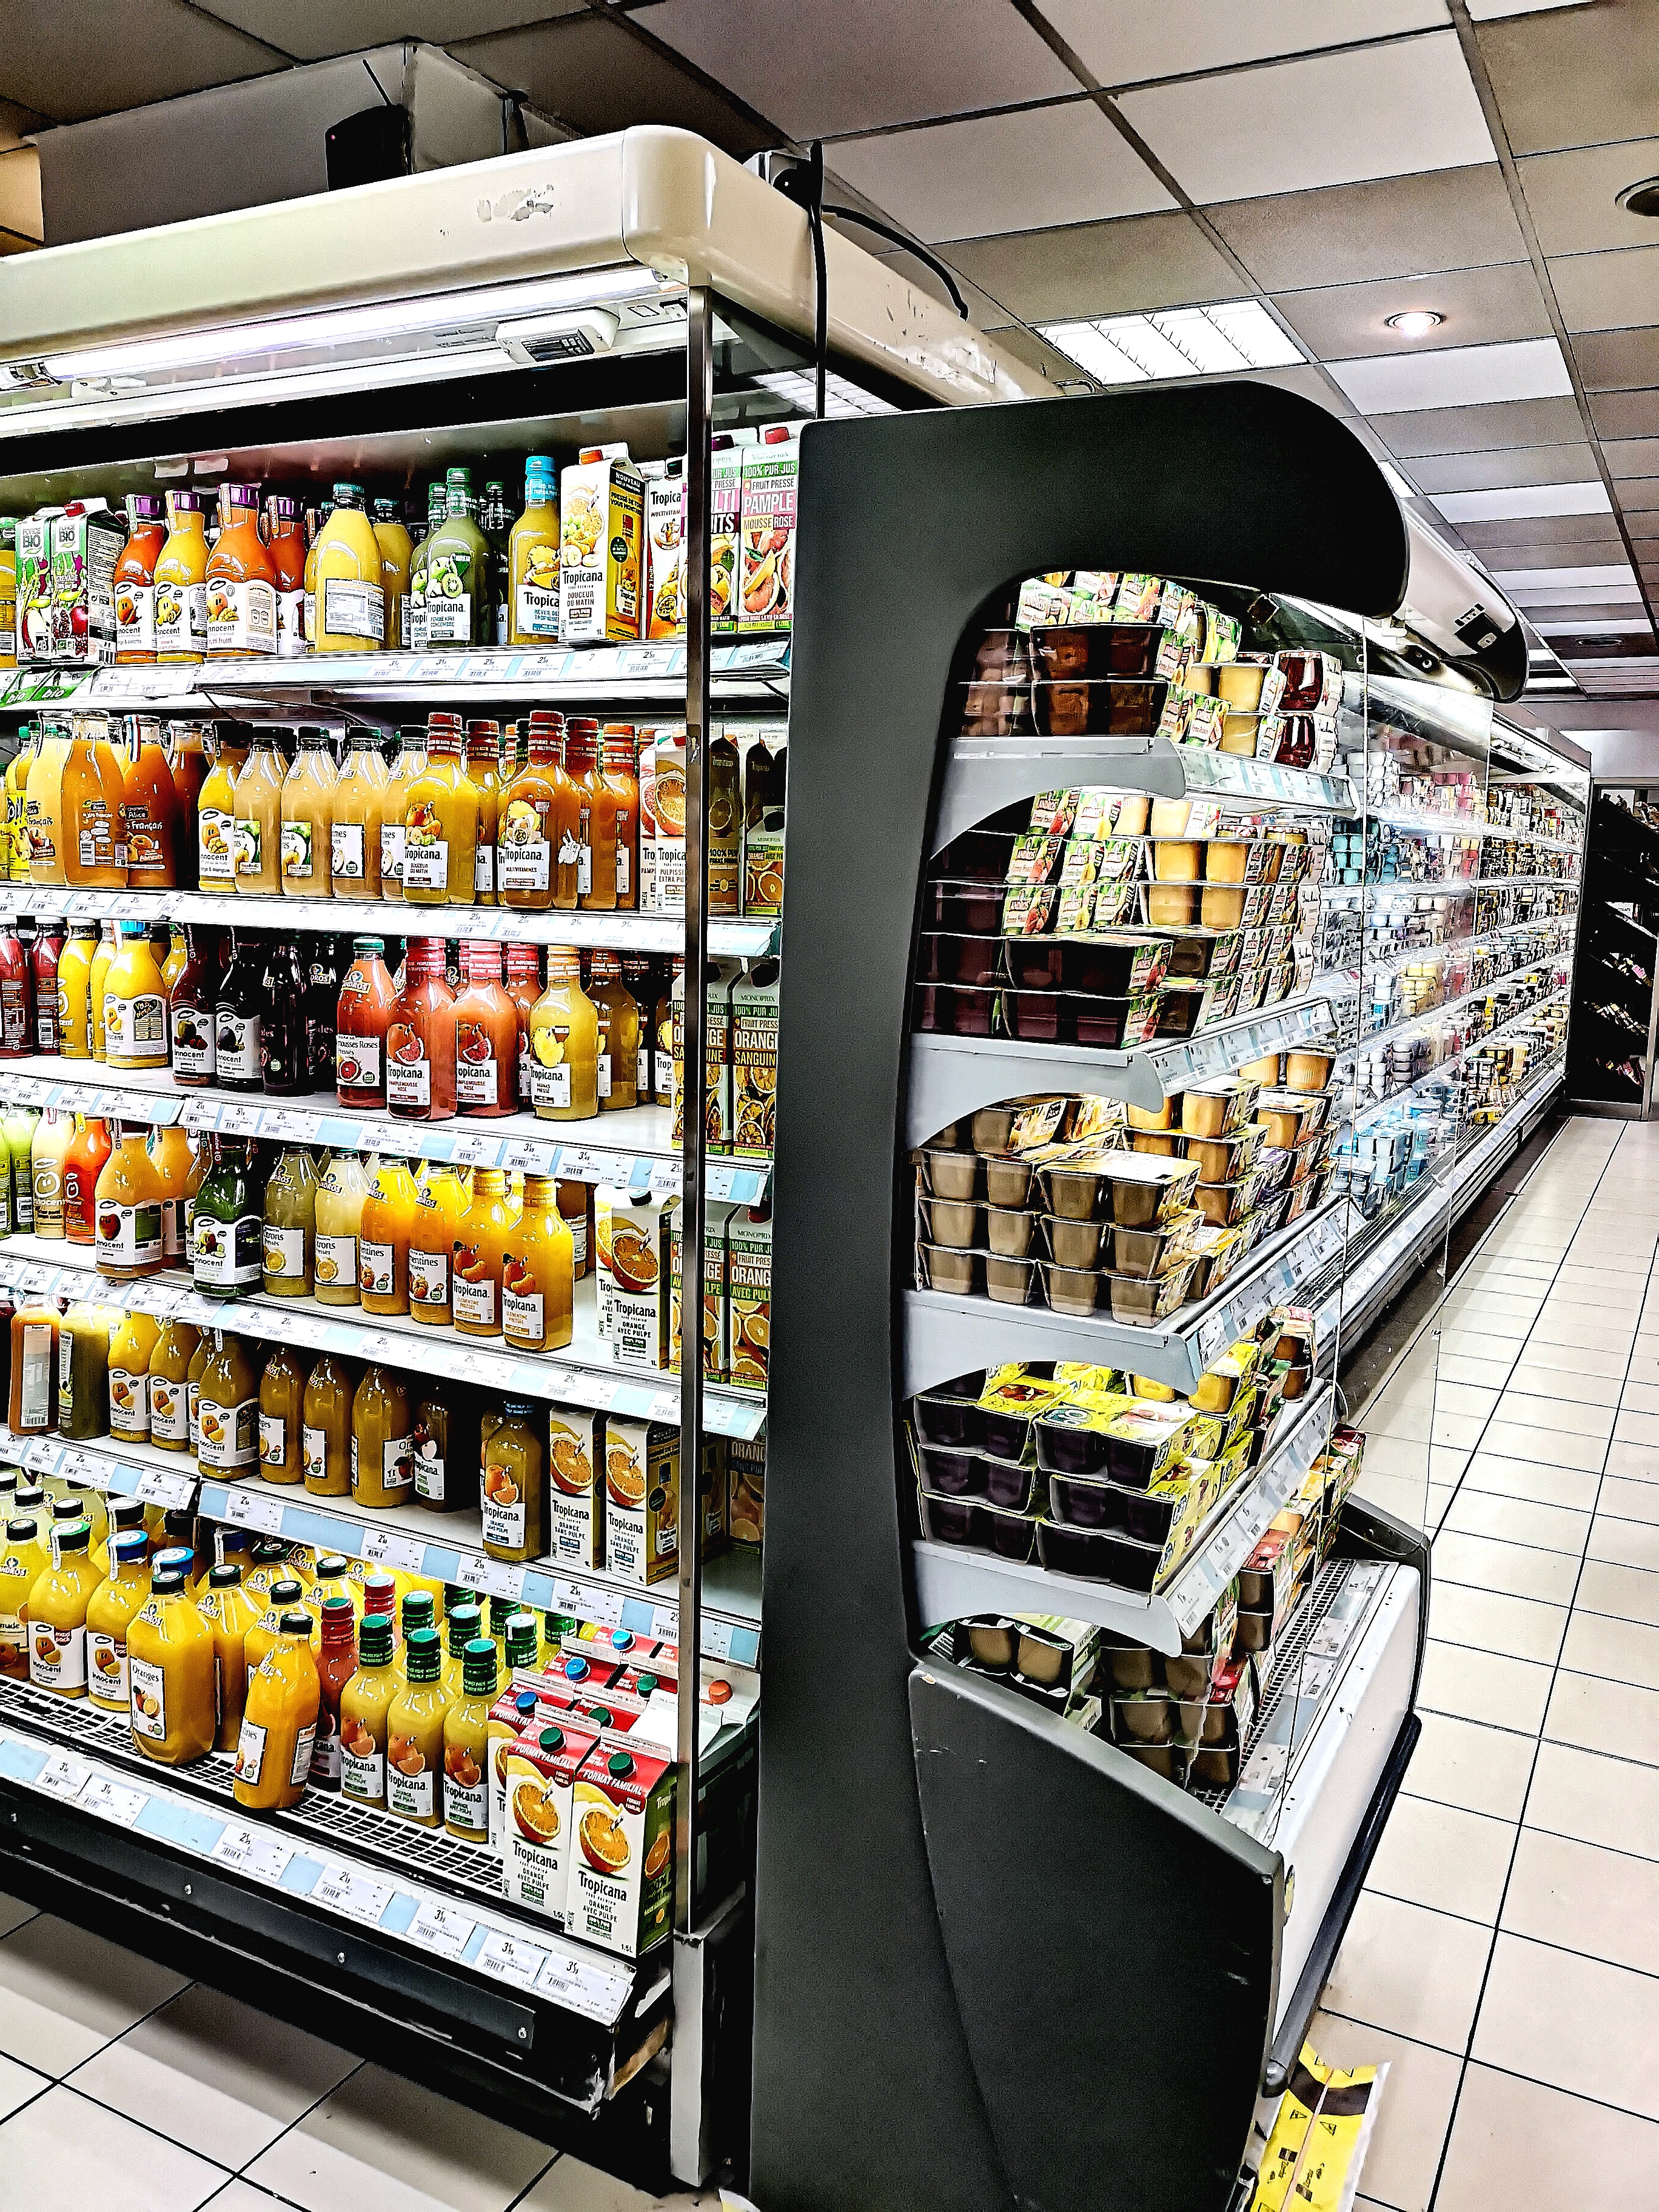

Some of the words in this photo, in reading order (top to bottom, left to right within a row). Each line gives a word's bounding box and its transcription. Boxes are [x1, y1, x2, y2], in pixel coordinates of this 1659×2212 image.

[723, 467, 737, 478] JUS
[745, 465, 763, 478] 100%
[764, 463, 779, 476] PUR
[781, 461, 796, 474] JUS
[715, 478, 736, 489] PRESSÉ
[752, 480, 769, 491] FRUIT
[771, 476, 795, 489] PRESSÉ
[650, 491, 682, 506] Tropica
[711, 488, 736, 514] LTI
[743, 491, 796, 515] PAMPLE
[650, 509, 682, 518] MULTIVITAM
[743, 516, 773, 531] MOUSSE
[774, 514, 794, 529] ROSE
[562, 570, 603, 585] Tropicana
[523, 592, 560, 608] Tropica
[568, 591, 595, 600] DOUCEUR
[427, 600, 465, 614] Tropicana
[411, 612, 427, 624] Tropi
[36, 639, 47, 651] AB
[7, 691, 25, 704] bio
[42, 688, 64, 700] bio
[332, 829, 347, 839] mes
[381, 830, 395, 839] mes
[201, 853, 229, 862] nnocent
[404, 846, 443, 861] Tropicana
[505, 847, 544, 861] Tropicana
[657, 847, 686, 862] Tropica
[740, 994, 776, 1002] MONOPRIX
[734, 1005, 751, 1015] 100%
[752, 1006, 767, 1016] PUR
[768, 1008, 778, 1017] JU
[742, 1018, 759, 1027] FRUIT
[759, 1019, 778, 1029] PRESS
[338, 1040, 358, 1048] mousses
[359, 1040, 378, 1048] Roses
[175, 1050, 204, 1058] innocent
[217, 1054, 241, 1064] nnocent
[734, 1051, 776, 1067] SANGUIN
[387, 1064, 423, 1079] Tropicana
[458, 1065, 491, 1078] ropicana
[530, 1066, 563, 1081] Tropicana
[270, 1173, 292, 1185] DROS
[317, 1241, 336, 1250] trons
[710, 1238, 723, 1249] JUS
[731, 1240, 748, 1251] 100%
[749, 1242, 763, 1253] PUR
[360, 1247, 384, 1258] entines
[409, 1255, 439, 1267] mentines
[738, 1254, 755, 1264] FRUIT
[756, 1256, 771, 1266] PRES
[732, 1265, 771, 1286] ORANG
[454, 1281, 489, 1299] Tropicana
[732, 1285, 751, 1299] AVEC
[753, 1287, 771, 1301] PUL
[503, 1293, 537, 1312] Tropicana
[614, 1299, 657, 1318] Tropicana
[617, 1327, 631, 1336] AVEC
[632, 1329, 652, 1338] PULPE
[622, 1321, 646, 1331] ORANGE
[415, 1461, 440, 1476] picana
[483, 1501, 521, 1521] Tropicana
[552, 1500, 591, 1520] Tropicana
[558, 1522, 580, 1532] ORANGE
[608, 1512, 644, 1535] Tropicana
[555, 1527, 568, 1536] SANS
[569, 1530, 586, 1540] PULPE
[614, 1534, 634, 1546] ORANGE
[610, 1539, 622, 1549] SANS
[623, 1543, 639, 1553] PULPE
[132, 1664, 159, 1682] Oranges
[515, 1744, 541, 1762] FORMAT
[540, 1751, 571, 1769] FAMILIAL
[388, 1770, 427, 1792] Tropicana
[583, 1769, 611, 1786] FORMAT
[611, 1777, 643, 1795] FAMILIAL
[444, 1780, 482, 1803] Tropicana
[512, 1840, 558, 1871] Tropicana
[522, 1868, 545, 1882] ORANGE
[517, 1874, 531, 1886] AVEC
[531, 1878, 549, 1891] PULPE
[578, 1871, 628, 1902] Tropicana
[589, 1899, 612, 1913] ORANGE
[582, 1905, 597, 1917] AVEC
[598, 1910, 617, 1923] PULPE
